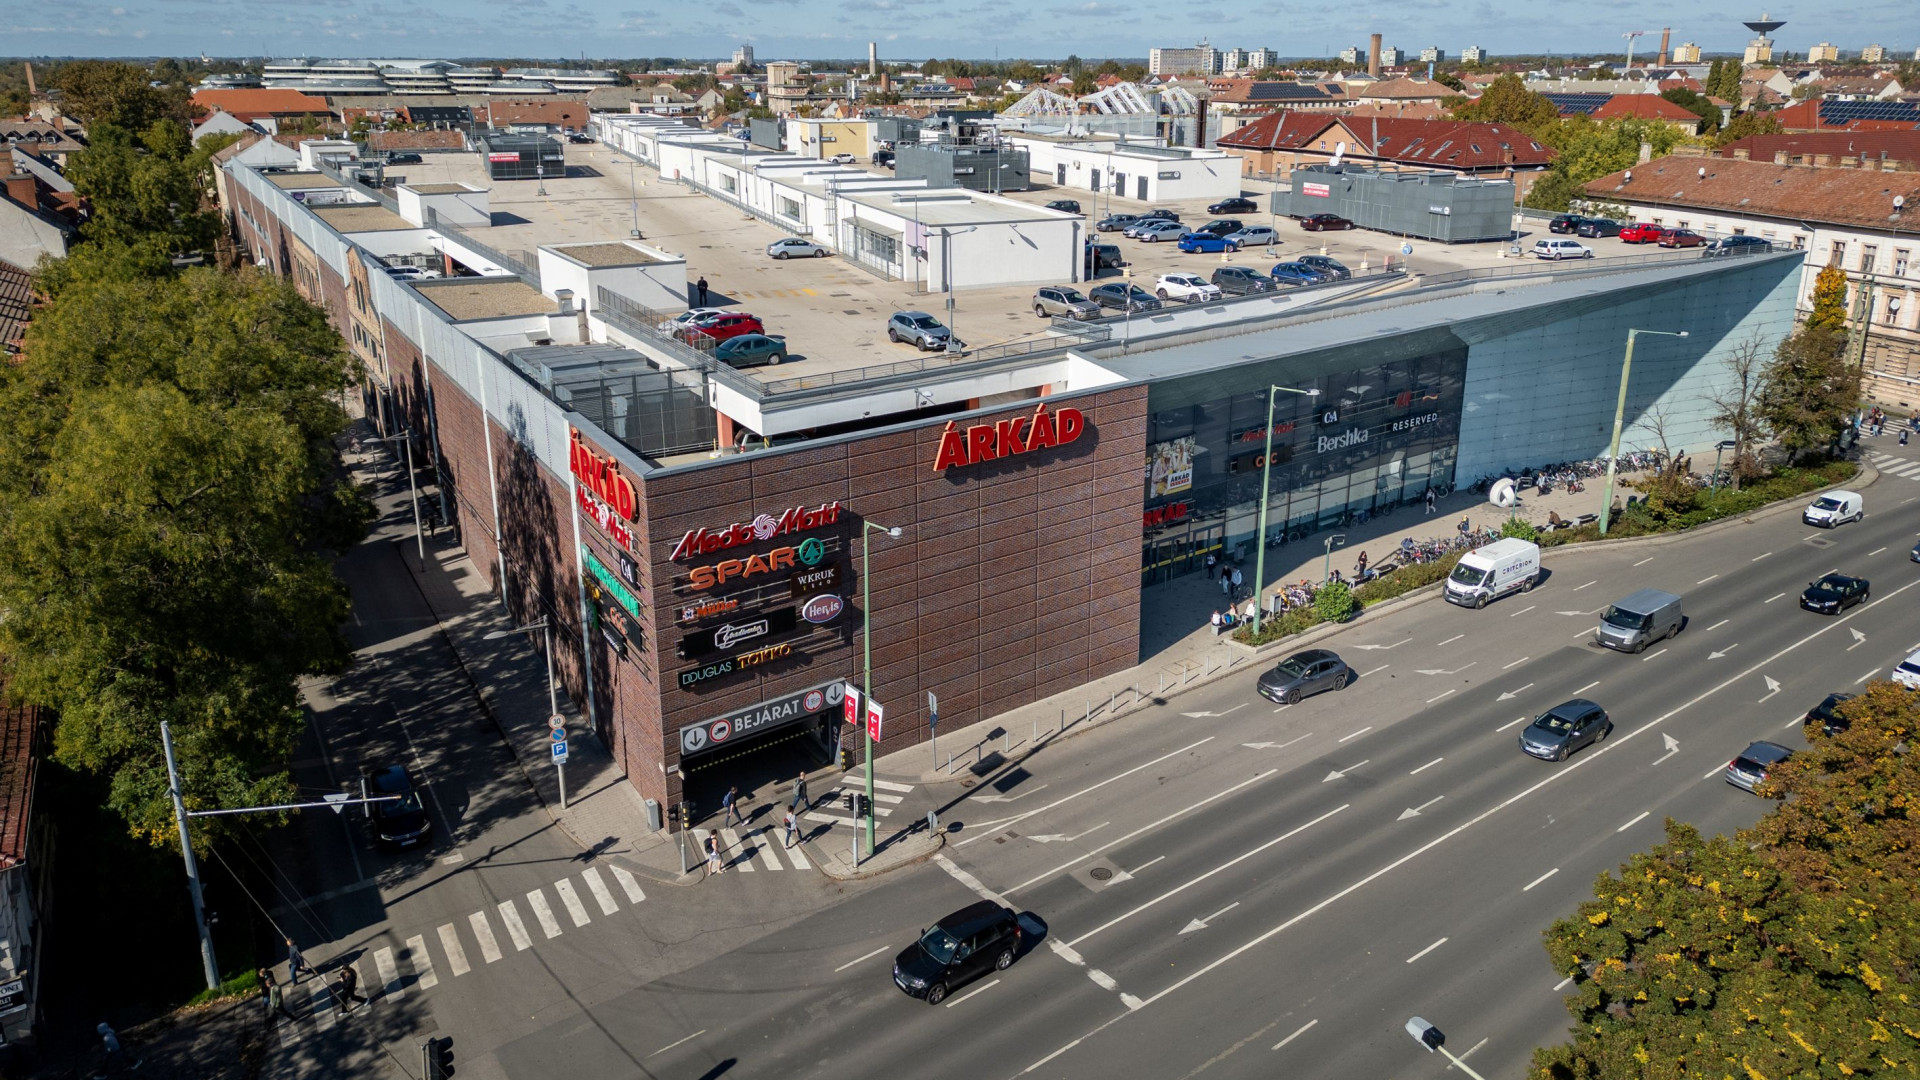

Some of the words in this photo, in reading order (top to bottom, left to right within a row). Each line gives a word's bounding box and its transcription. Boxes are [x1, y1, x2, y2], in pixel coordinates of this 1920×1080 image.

[1324, 410, 1338, 424] C&A
[1392, 412, 1438, 432] RESERVED
[933, 403, 1084, 472] ÁRKÁD
[1317, 428, 1369, 454] Bershka
[570, 426, 637, 522] ÁRKÁD
[1143, 502, 1188, 527] RKÁD
[620, 558, 634, 583] C&A
[689, 546, 795, 591] SPAR
[1502, 559, 1533, 575] CRITERION
[696, 599, 739, 618] Müller
[808, 601, 839, 618] Hervis
[610, 607, 628, 635] CCC
[682, 662, 732, 685] DOUGLAS
[734, 699, 800, 733] BEJÁRAT
[556, 745, 564, 754] P
[0, 983, 21, 995] ONT
